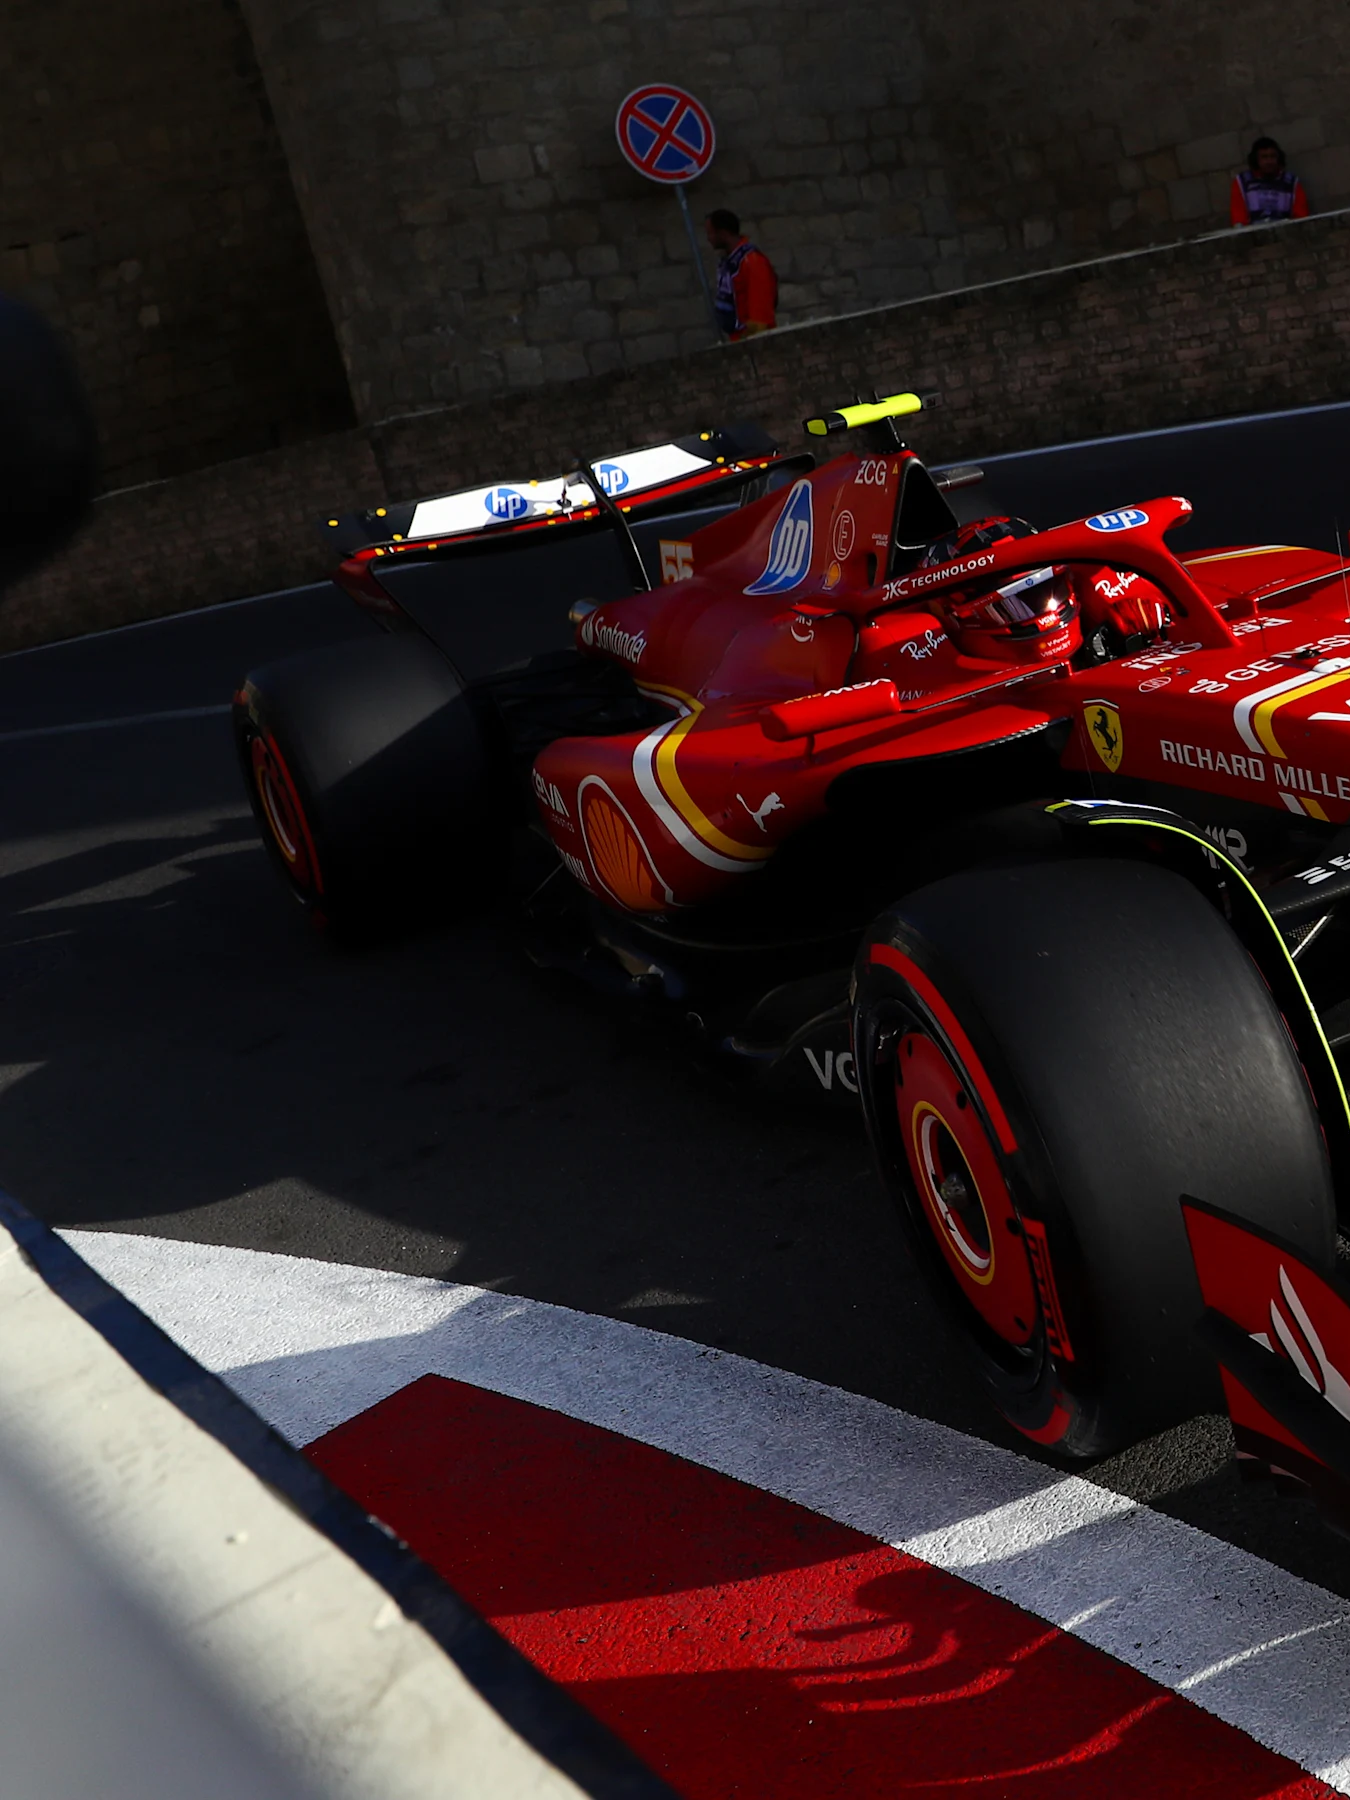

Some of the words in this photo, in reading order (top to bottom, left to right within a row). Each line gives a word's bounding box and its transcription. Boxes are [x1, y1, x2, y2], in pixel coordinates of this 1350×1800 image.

[854, 459, 887, 484] ZCG
[488, 488, 524, 518] hp
[1094, 509, 1142, 531] hp
[749, 482, 810, 593] hp
[659, 540, 694, 583] 55
[882, 578, 909, 601] DXC
[911, 554, 996, 588] TECHNOLOGY
[595, 615, 648, 664] Santander
[1160, 739, 1265, 782] RICHARD
